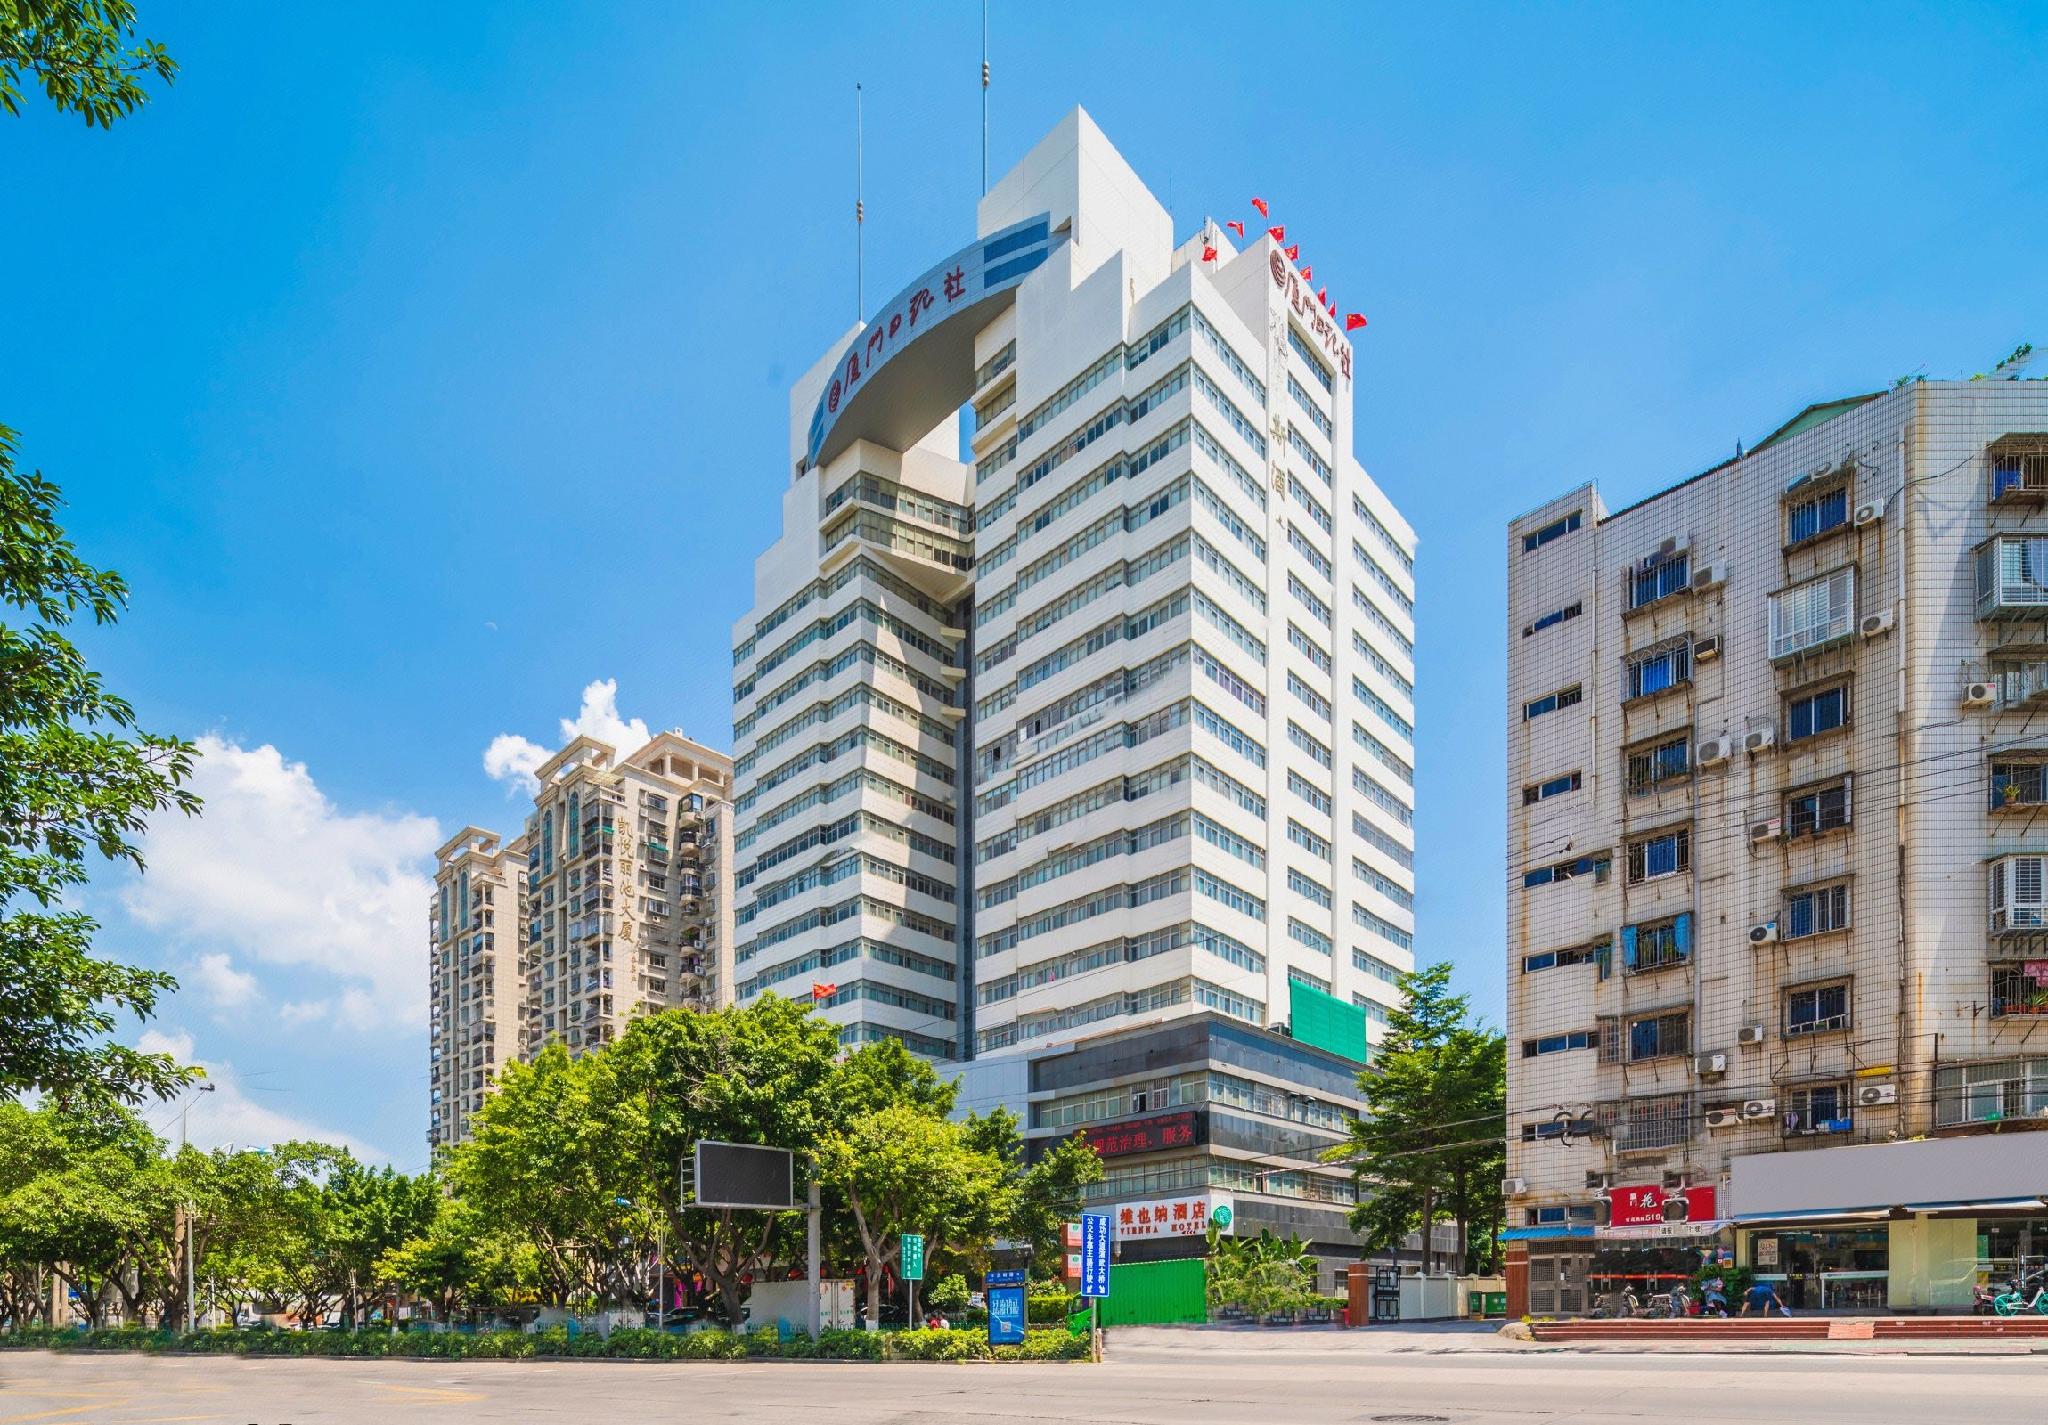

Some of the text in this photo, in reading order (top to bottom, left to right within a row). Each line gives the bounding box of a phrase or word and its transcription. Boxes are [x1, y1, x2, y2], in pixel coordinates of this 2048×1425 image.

[617, 816, 635, 943] 凯悦丽池大厦
[1120, 1200, 1207, 1226] 维也纳酒店
[1120, 1220, 1207, 1236] VIENNA HOTEL
